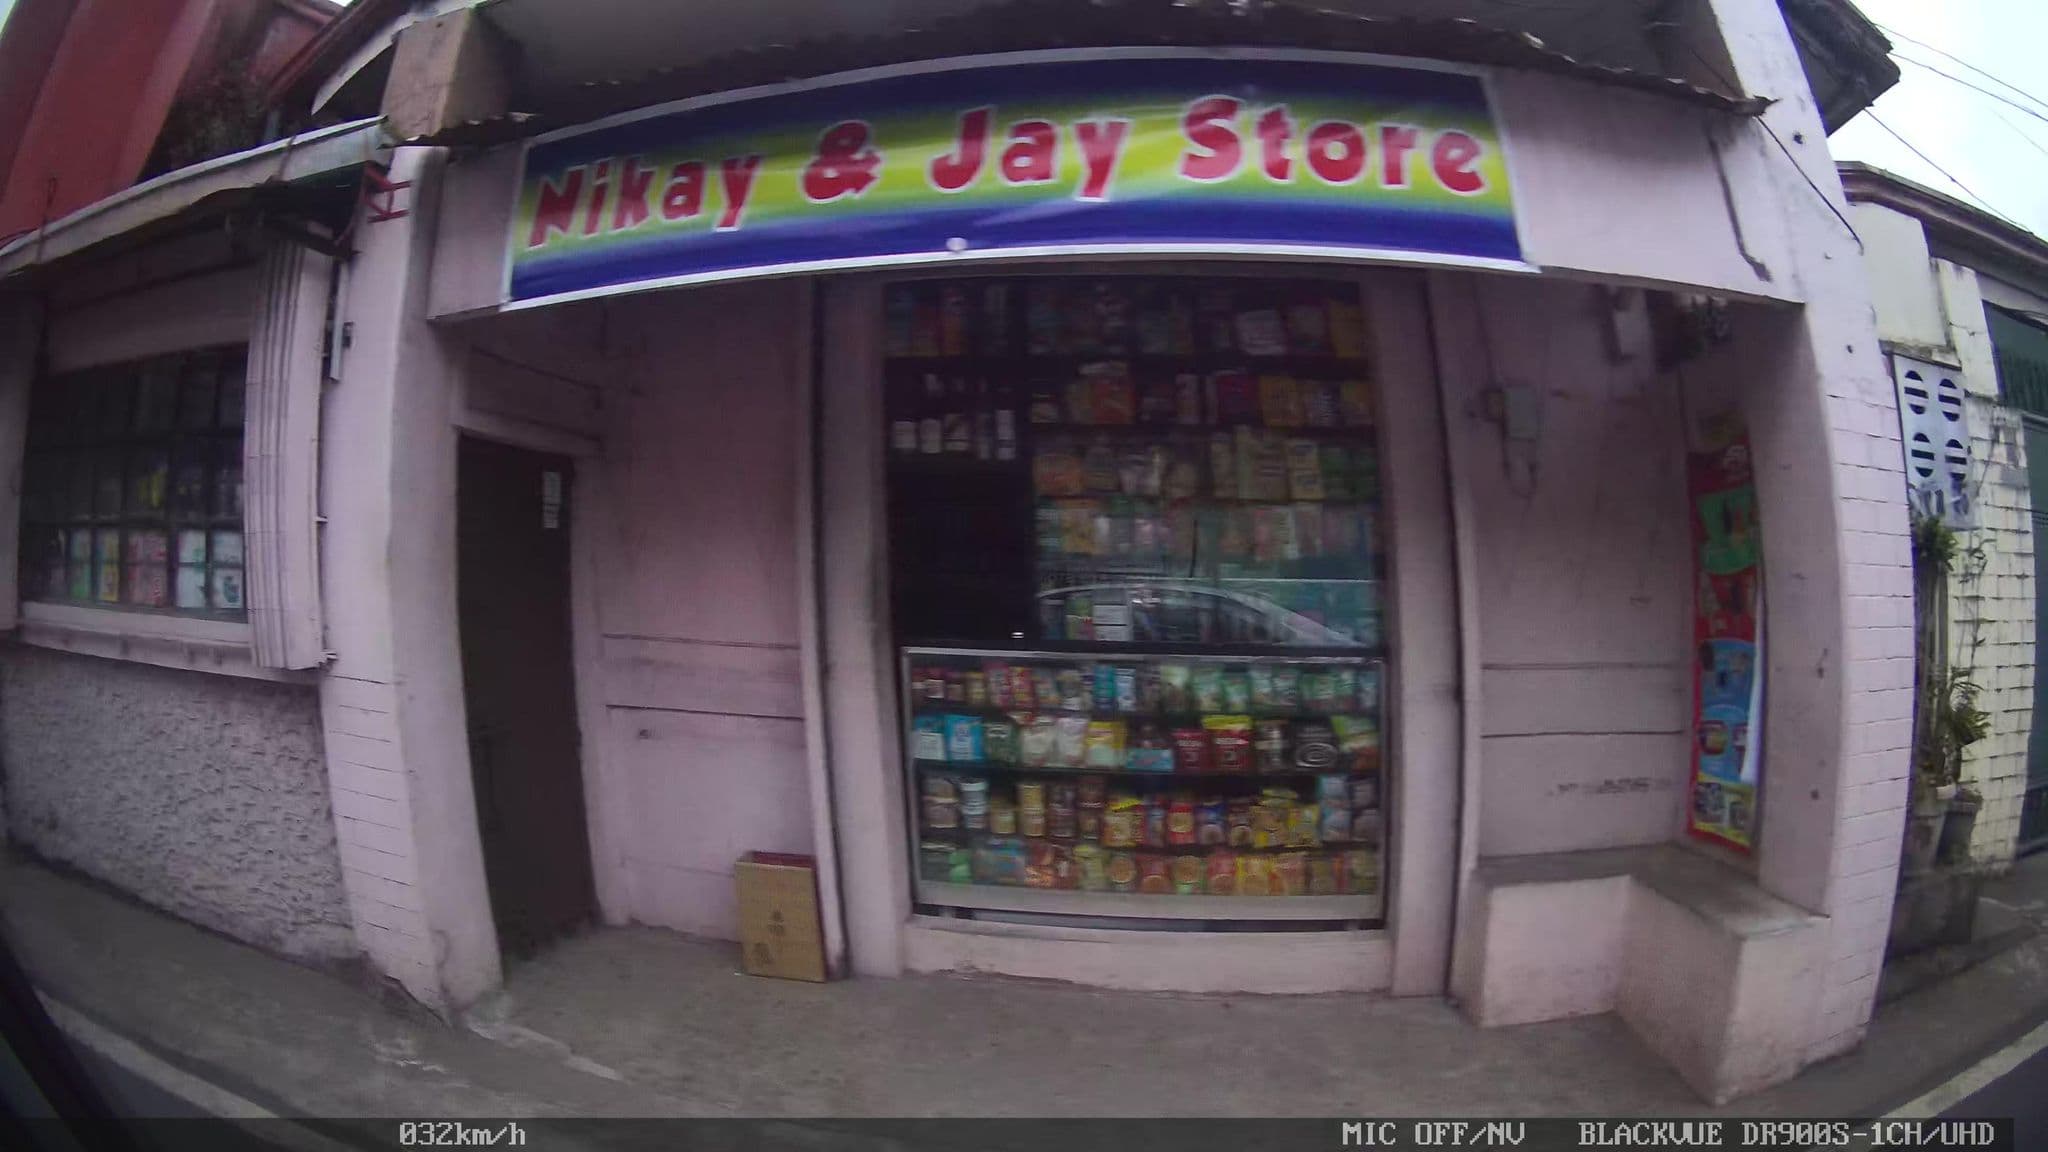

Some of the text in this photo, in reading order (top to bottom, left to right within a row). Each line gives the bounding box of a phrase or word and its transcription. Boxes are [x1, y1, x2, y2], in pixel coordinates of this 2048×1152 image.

[526, 95, 1488, 251] Nikay & Jay Store
